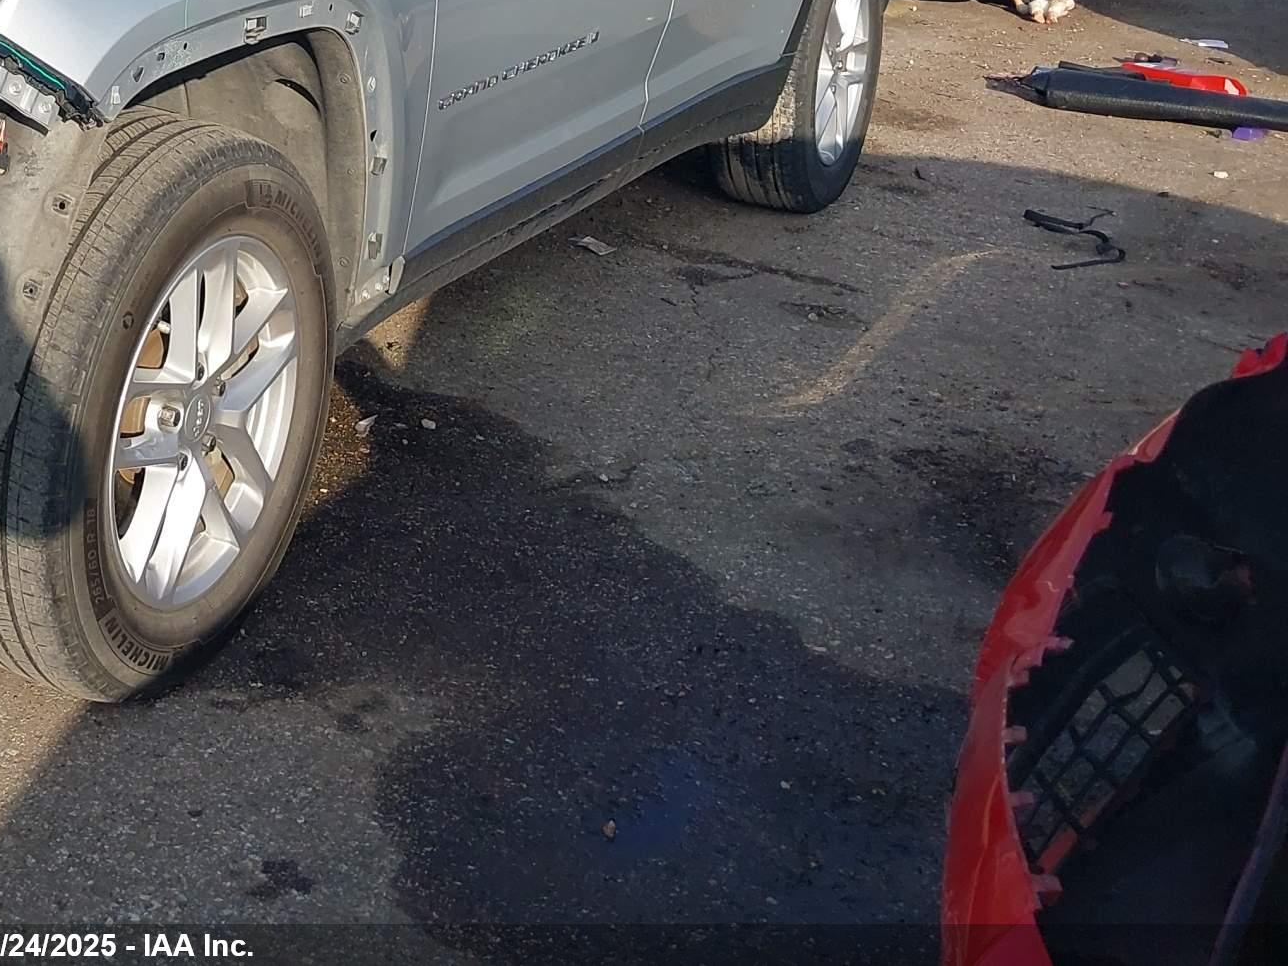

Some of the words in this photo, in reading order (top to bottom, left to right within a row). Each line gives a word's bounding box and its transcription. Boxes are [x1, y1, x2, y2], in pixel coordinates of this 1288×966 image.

[438, 75, 499, 110] GRAND
[502, 36, 586, 81] CHEROKEE
[274, 189, 321, 257] MICHELIN
[104, 616, 170, 671] MICHELIN
